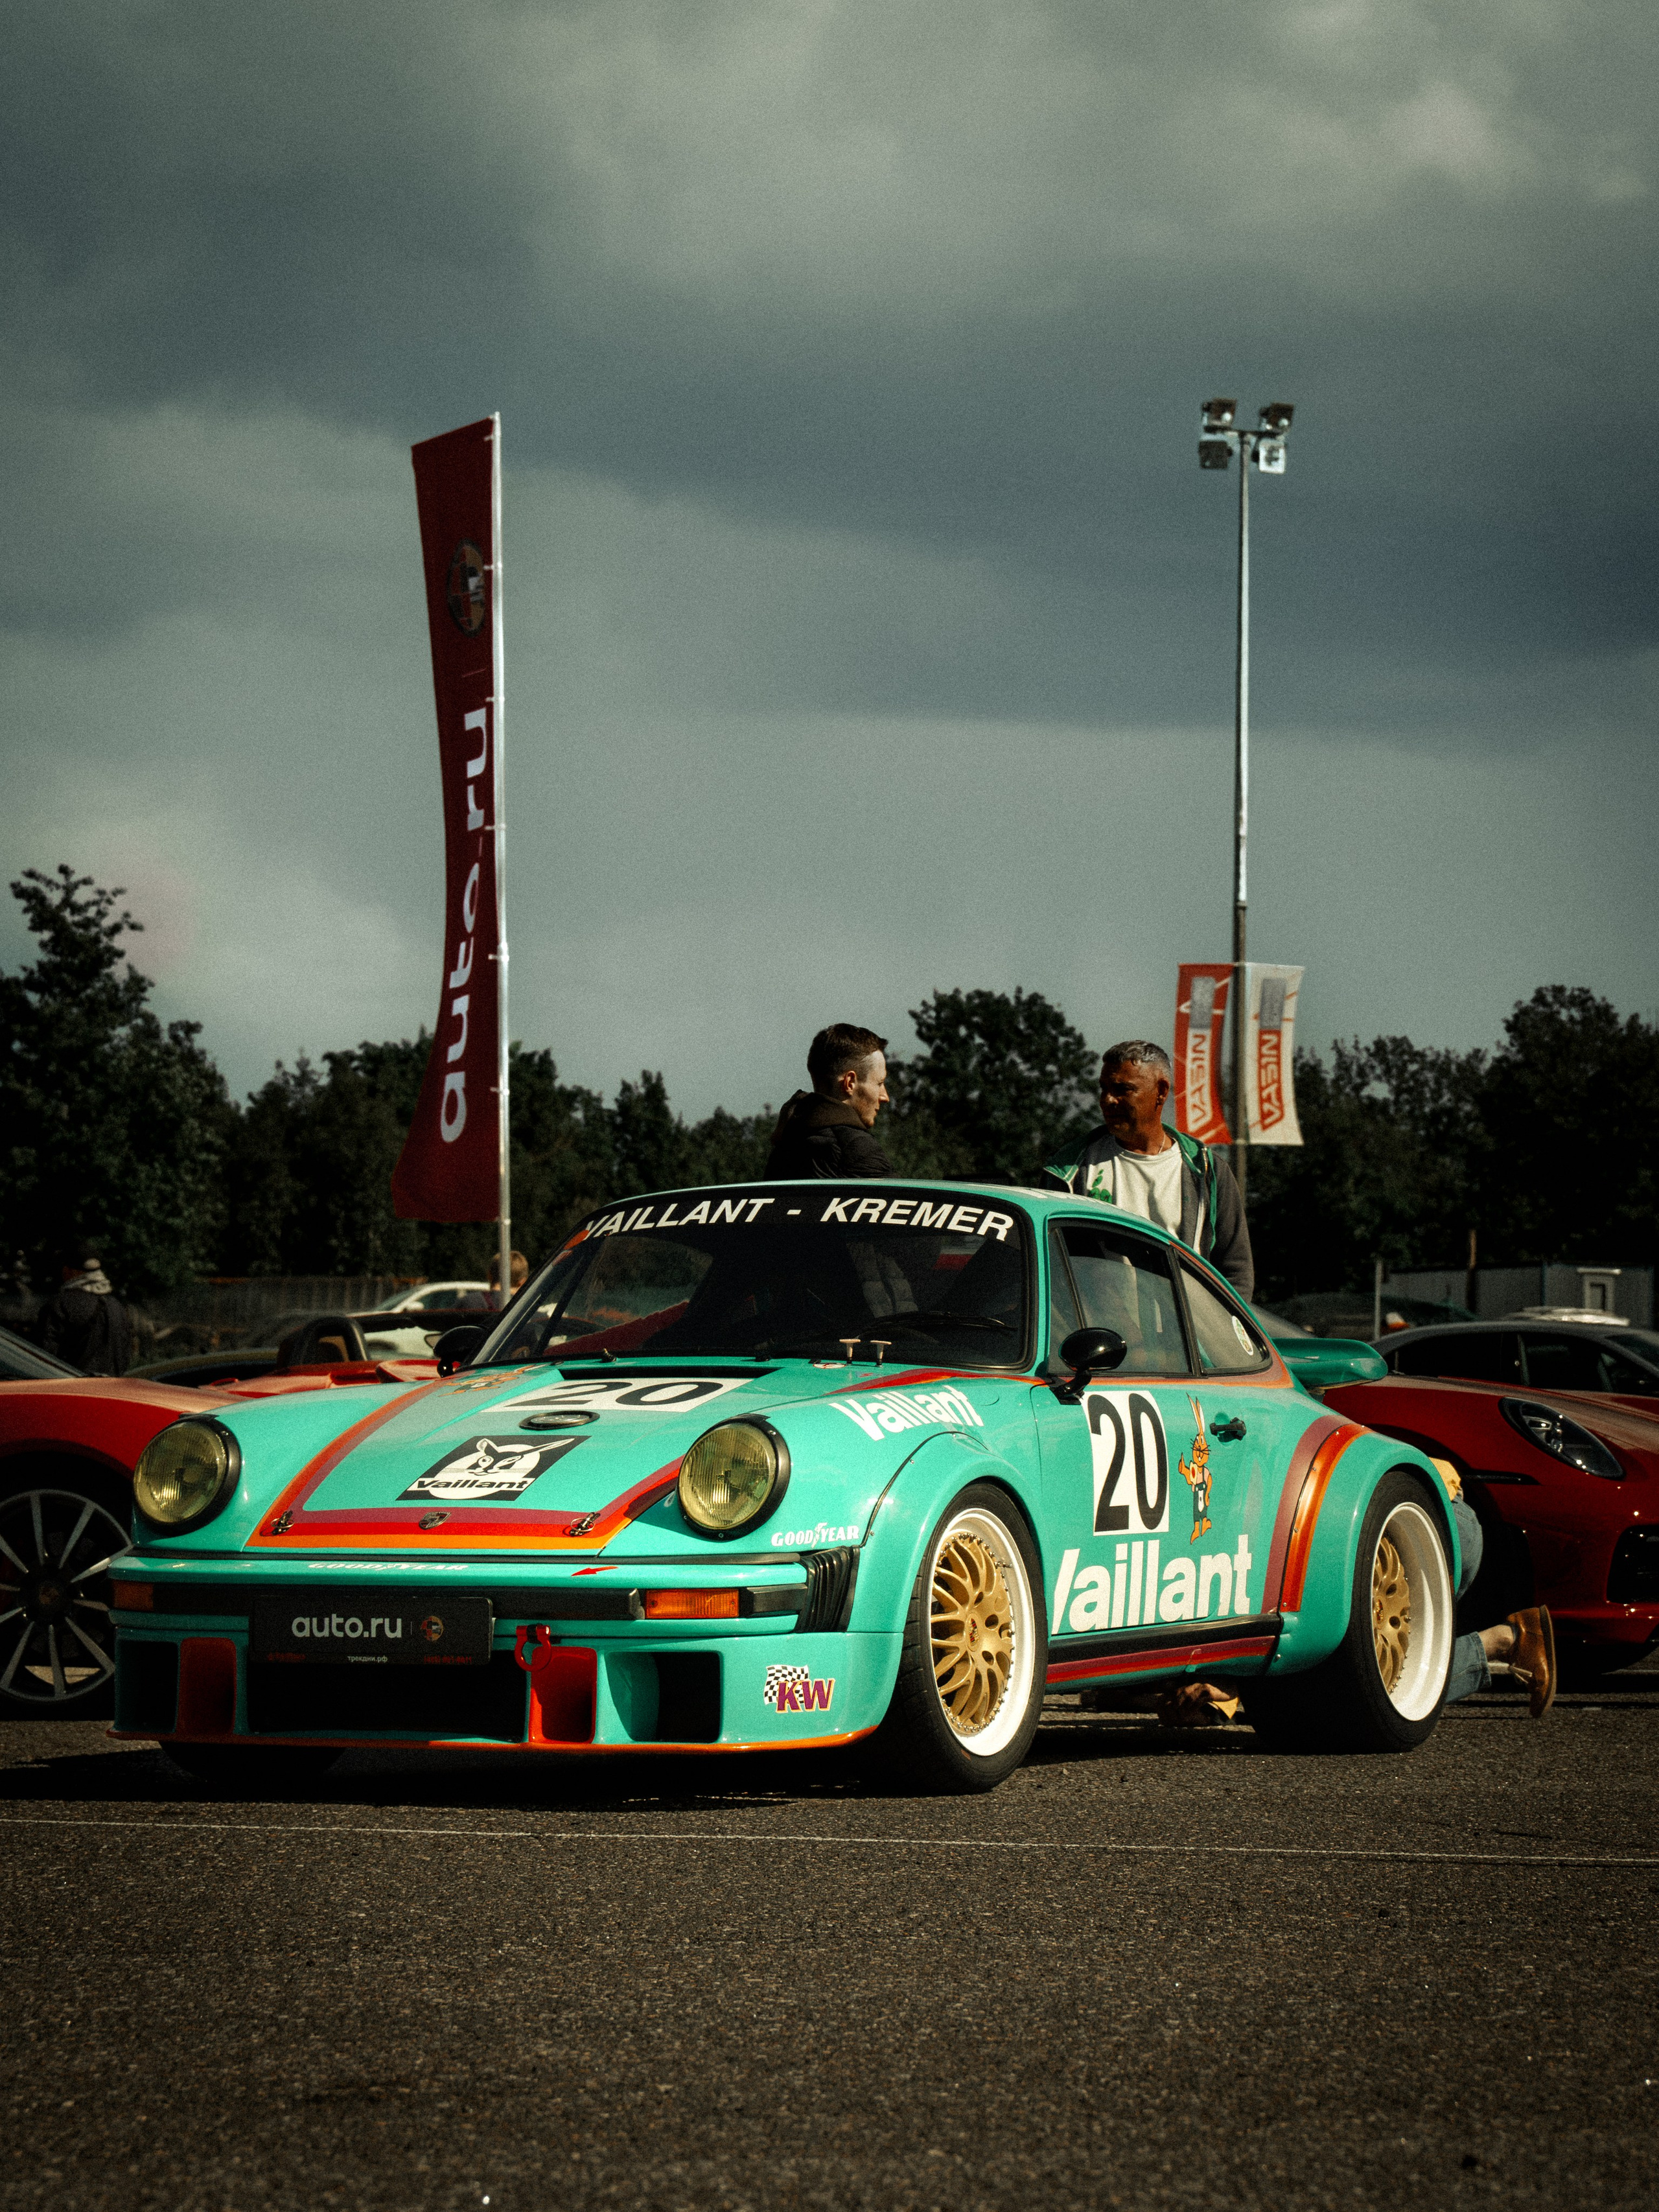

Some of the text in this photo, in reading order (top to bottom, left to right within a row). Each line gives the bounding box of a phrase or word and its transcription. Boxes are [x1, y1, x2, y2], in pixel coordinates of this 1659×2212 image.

[441, 706, 487, 1143] autoru
[1190, 1034, 1207, 1124] VASIN
[1261, 1034, 1282, 1126] VASIN
[583, 1198, 775, 1241] VAILLANT
[820, 1198, 1014, 1241] KREMER
[504, 1381, 724, 1407] 20
[828, 1385, 984, 1441] Vaillant
[1087, 1393, 1167, 1533] 20
[417, 1480, 528, 1489] Vaillant
[771, 1522, 860, 1548] GOODYEAR
[292, 1613, 402, 1638] auto.ru
[347, 1655, 388, 1663] трекдни.рф
[776, 1678, 836, 1714] KW
